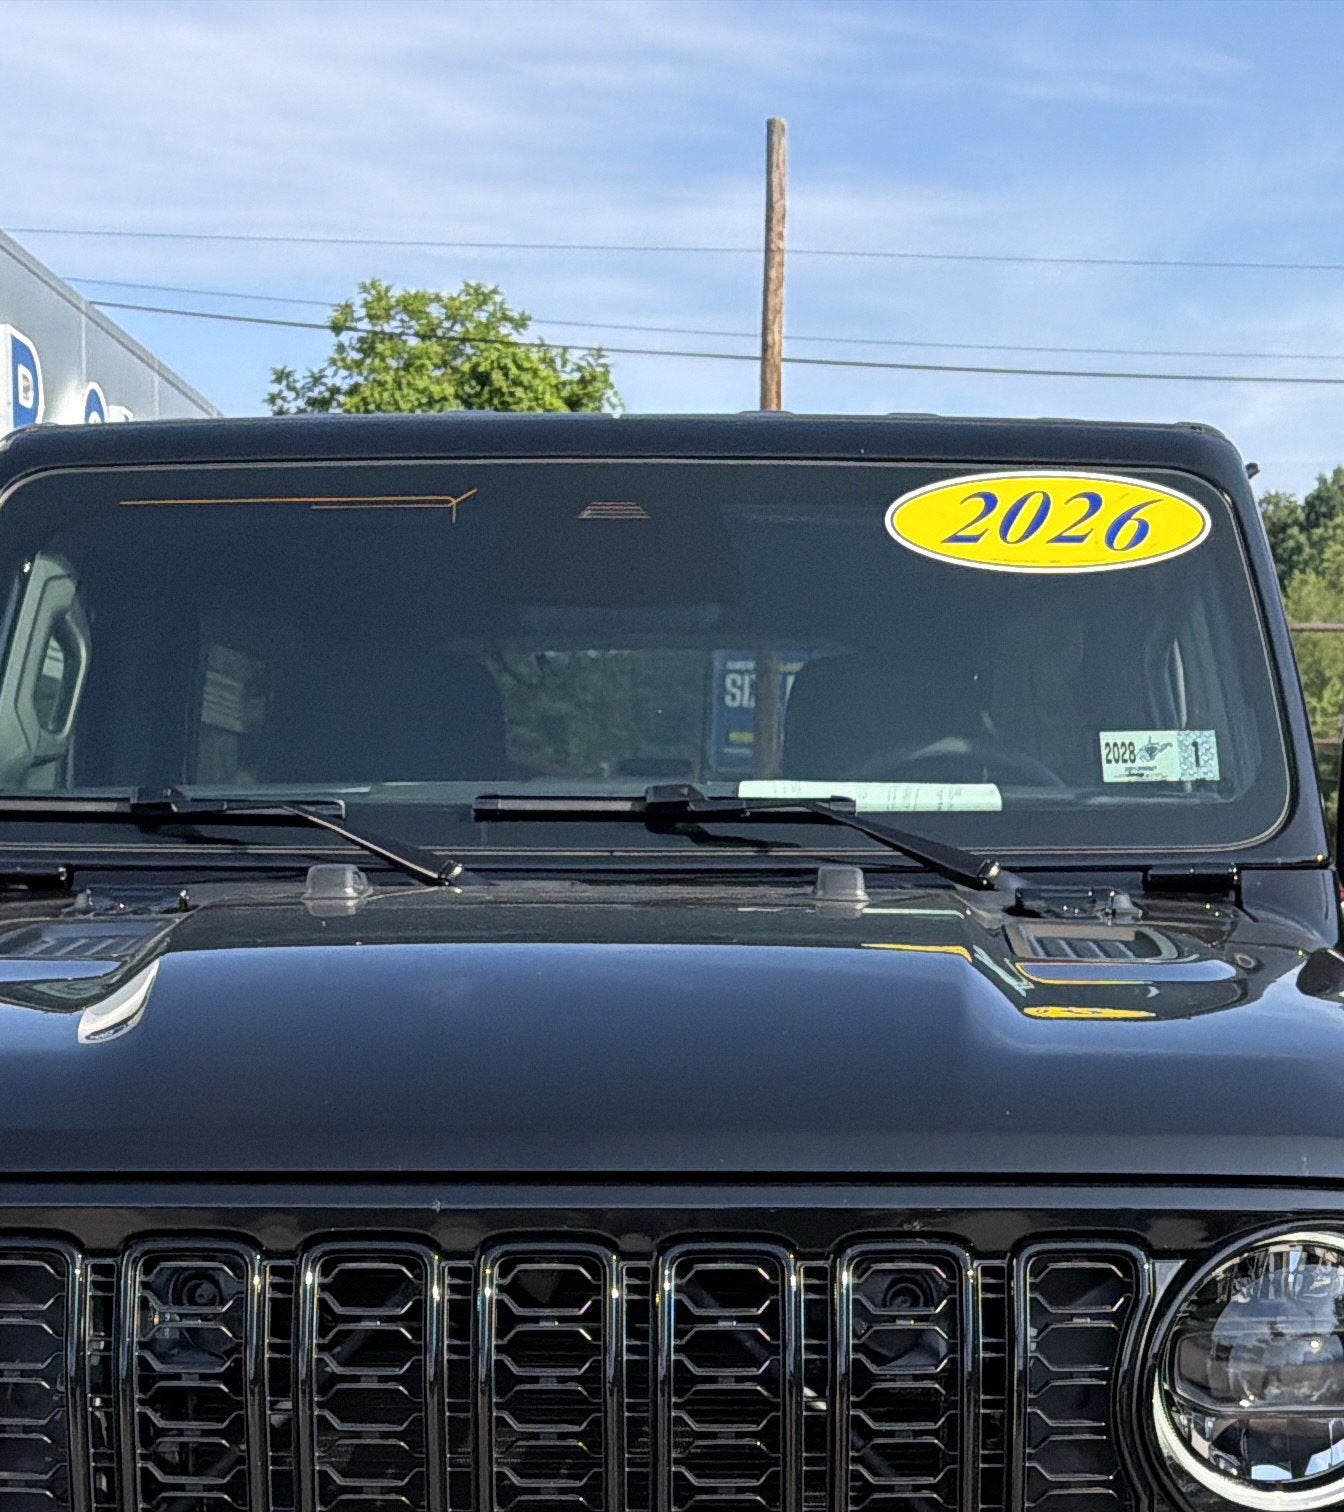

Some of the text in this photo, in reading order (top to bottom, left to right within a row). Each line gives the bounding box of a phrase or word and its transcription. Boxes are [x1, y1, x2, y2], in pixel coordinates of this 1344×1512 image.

[940, 490, 1165, 552] 2026
[1104, 741, 1201, 768] 2028 1
